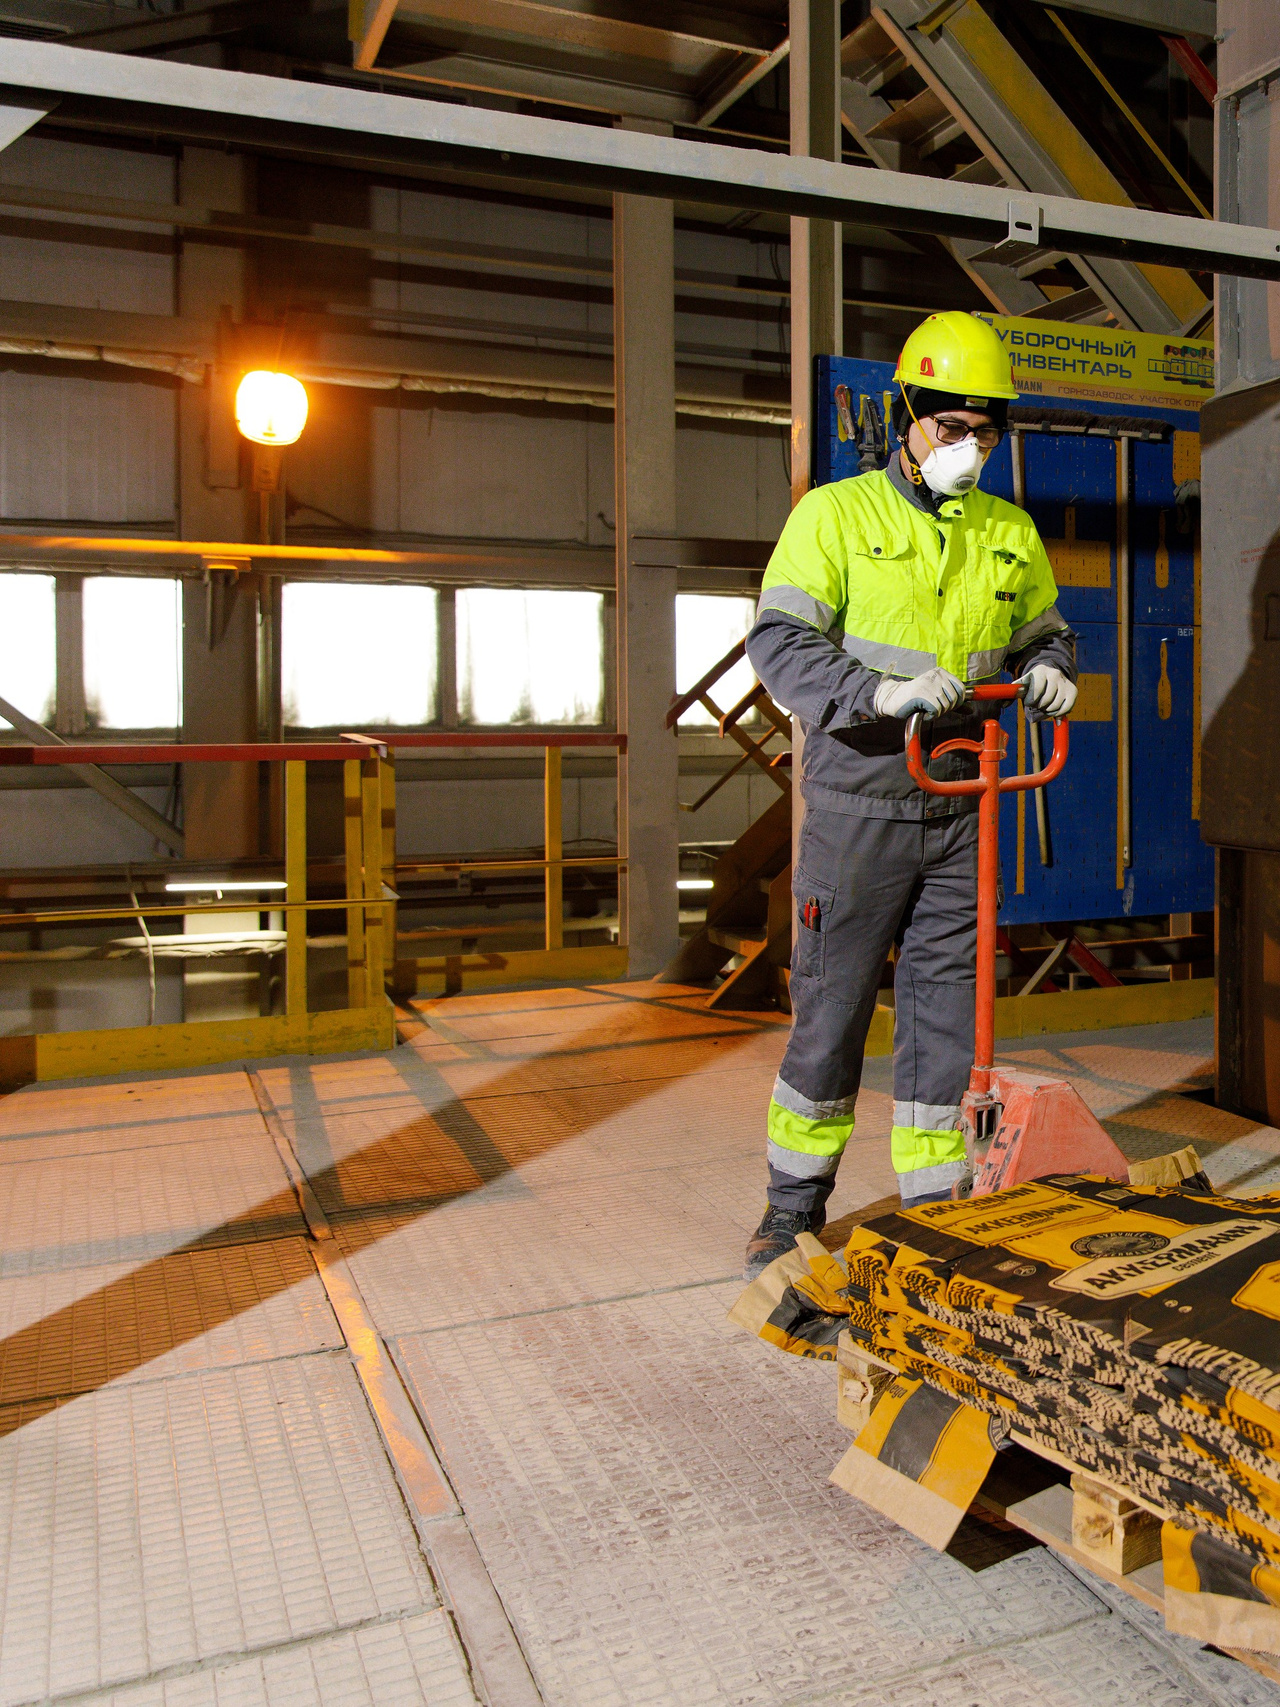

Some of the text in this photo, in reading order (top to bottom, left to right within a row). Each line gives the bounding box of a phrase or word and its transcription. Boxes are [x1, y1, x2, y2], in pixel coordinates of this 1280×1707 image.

[995, 328, 1136, 359] УБОРОЧНЫЙ
[1147, 358, 1214, 378] mölle
[1139, 395, 1182, 407] УЧАСТОК
[920, 1187, 1037, 1219] AKKERMANN
[964, 1203, 1085, 1235] AKKERMANN
